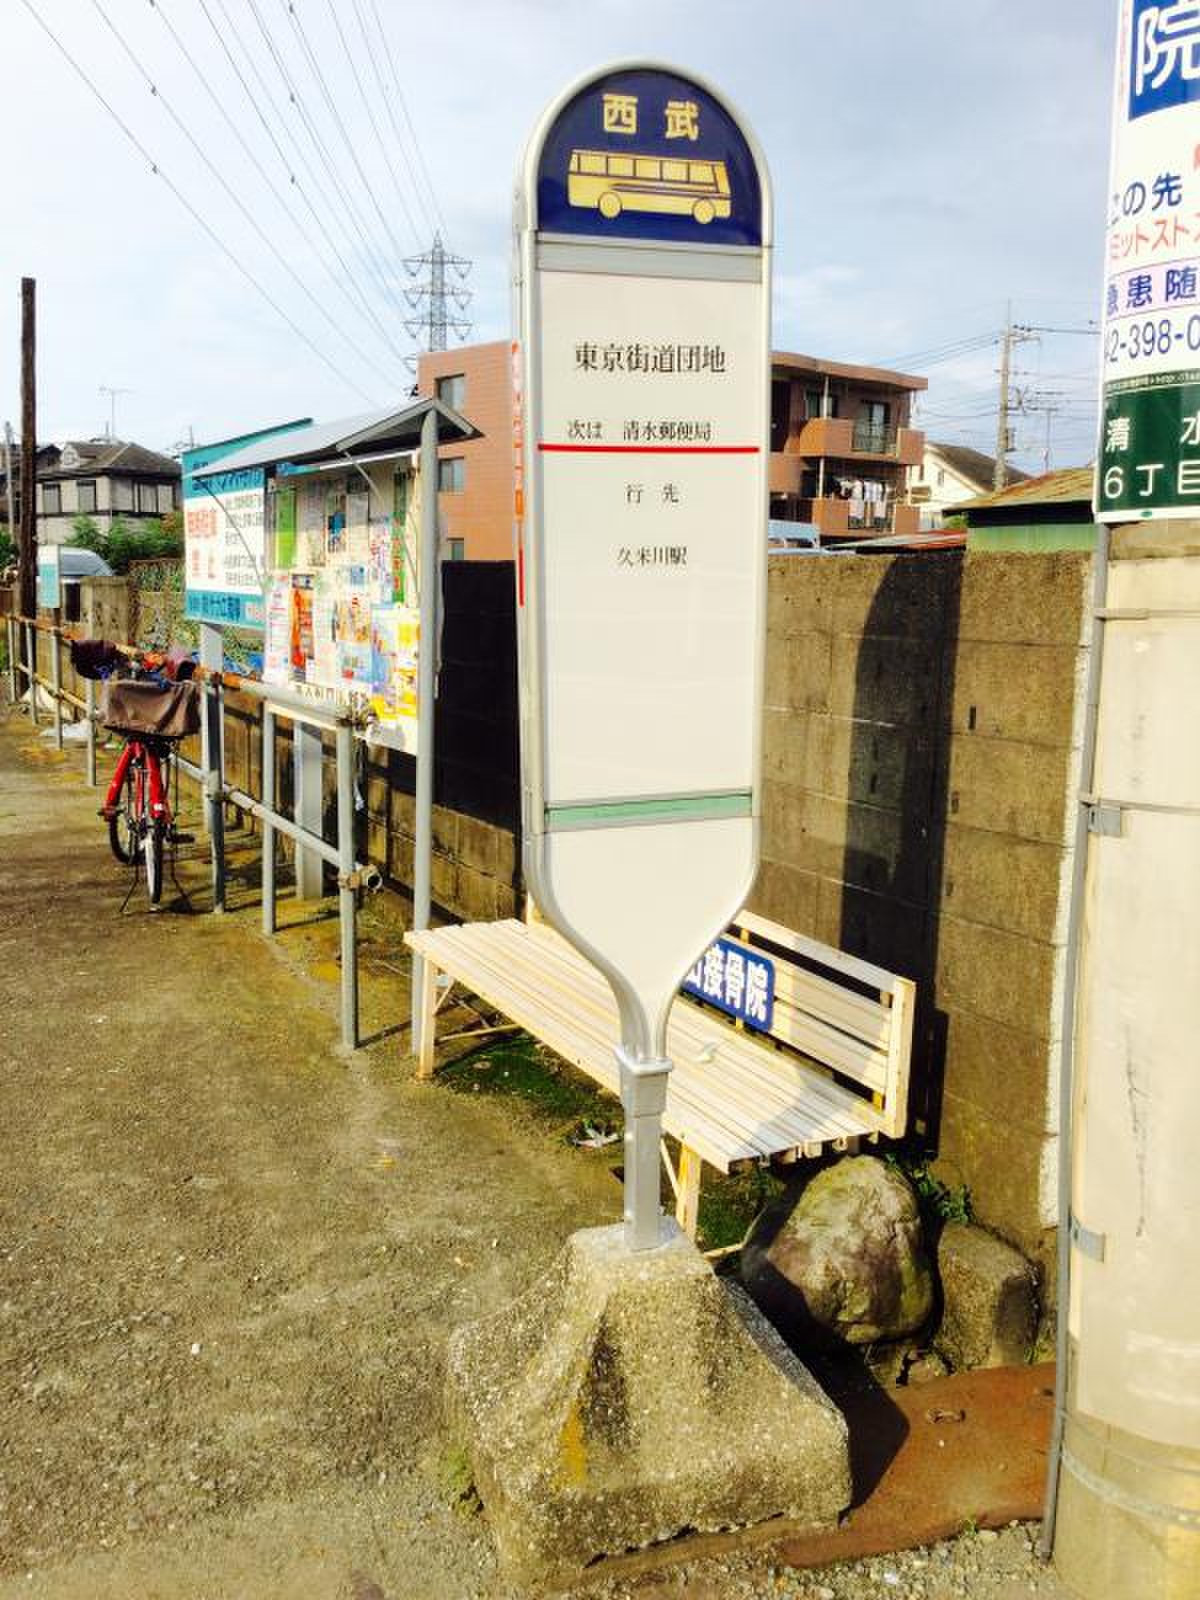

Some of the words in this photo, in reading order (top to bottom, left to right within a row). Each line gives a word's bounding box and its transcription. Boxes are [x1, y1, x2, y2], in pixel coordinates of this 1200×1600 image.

[1136, 0, 1200, 97] 院
[603, 94, 699, 141] 西武
[1110, 213, 1200, 260] ミットスト
[575, 343, 726, 373] 東京街道団地
[567, 419, 603, 440] 次は
[623, 420, 711, 441] 清水郵便局
[625, 483, 680, 503] 行先
[617, 546, 687, 567] 久米川駅
